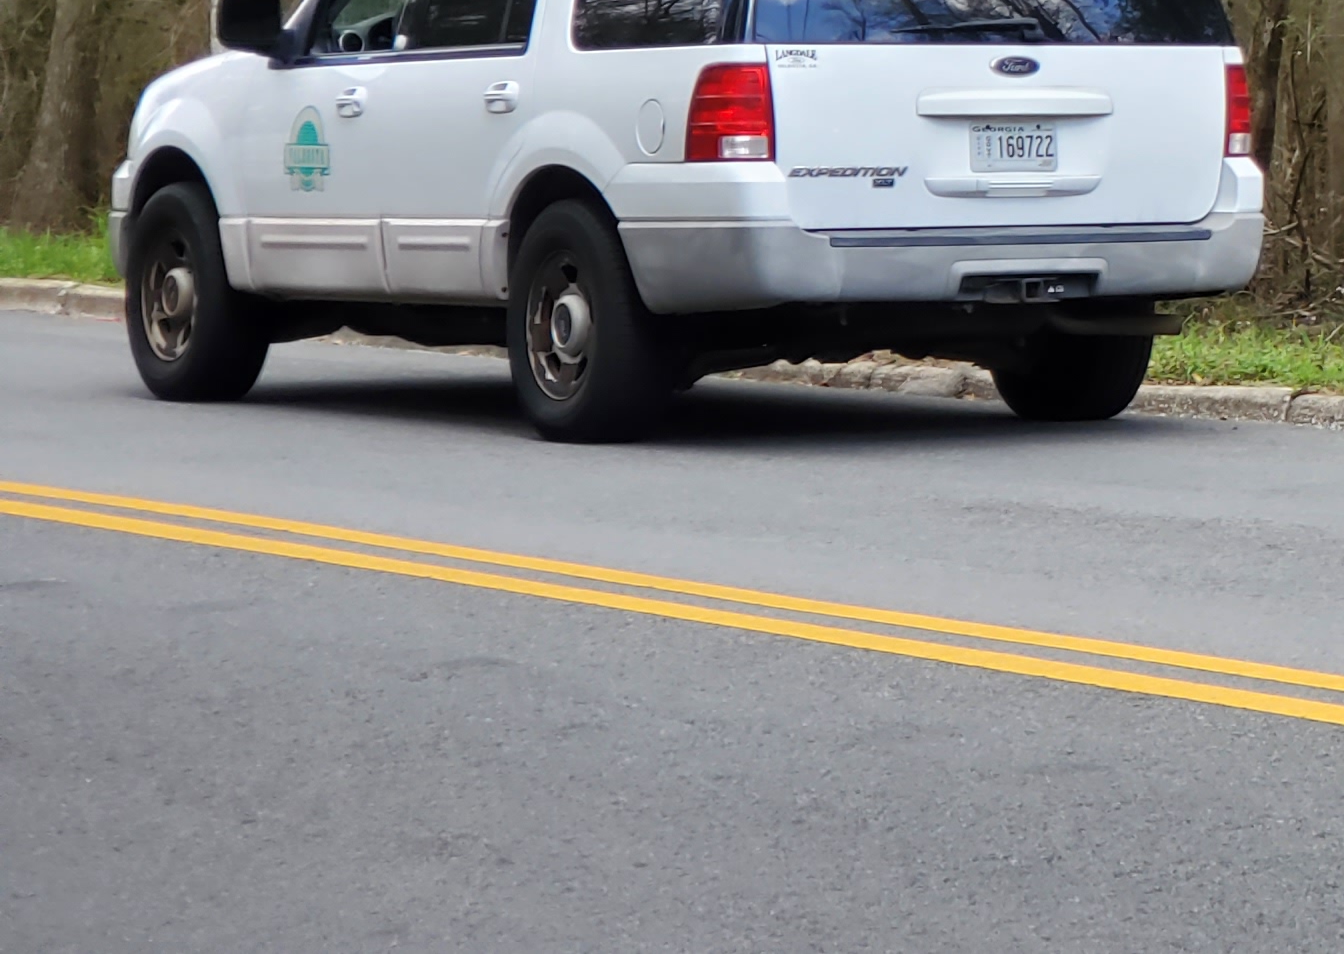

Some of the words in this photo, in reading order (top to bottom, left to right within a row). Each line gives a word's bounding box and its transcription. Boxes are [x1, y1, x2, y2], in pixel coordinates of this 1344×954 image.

[775, 49, 818, 61] LANGDALE
[1002, 58, 1029, 72] Ford
[998, 135, 1054, 158] 169722
[788, 165, 908, 178] EXPEDITION
